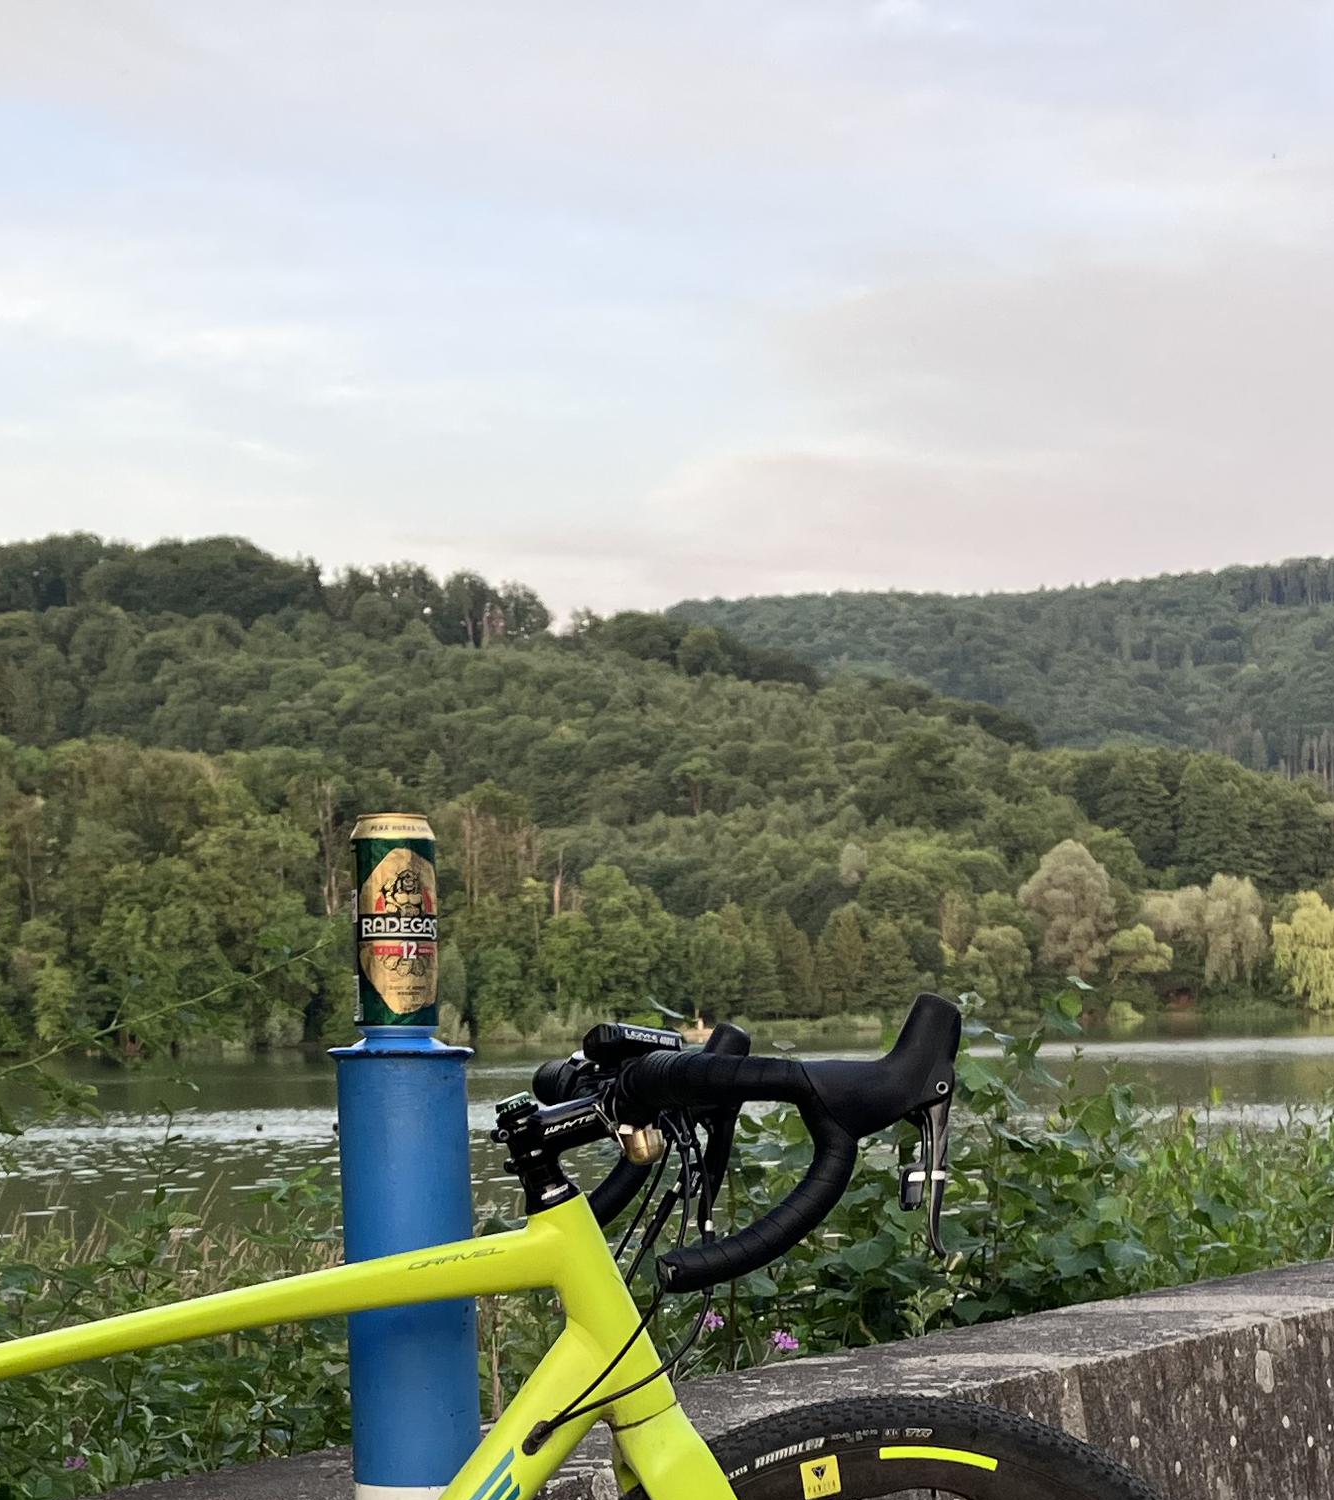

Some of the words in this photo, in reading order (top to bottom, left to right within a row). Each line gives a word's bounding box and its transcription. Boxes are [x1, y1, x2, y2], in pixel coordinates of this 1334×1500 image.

[362, 916, 437, 940] RADEGAS
[401, 941, 418, 959] 12
[408, 1247, 505, 1270] GRAVEL
